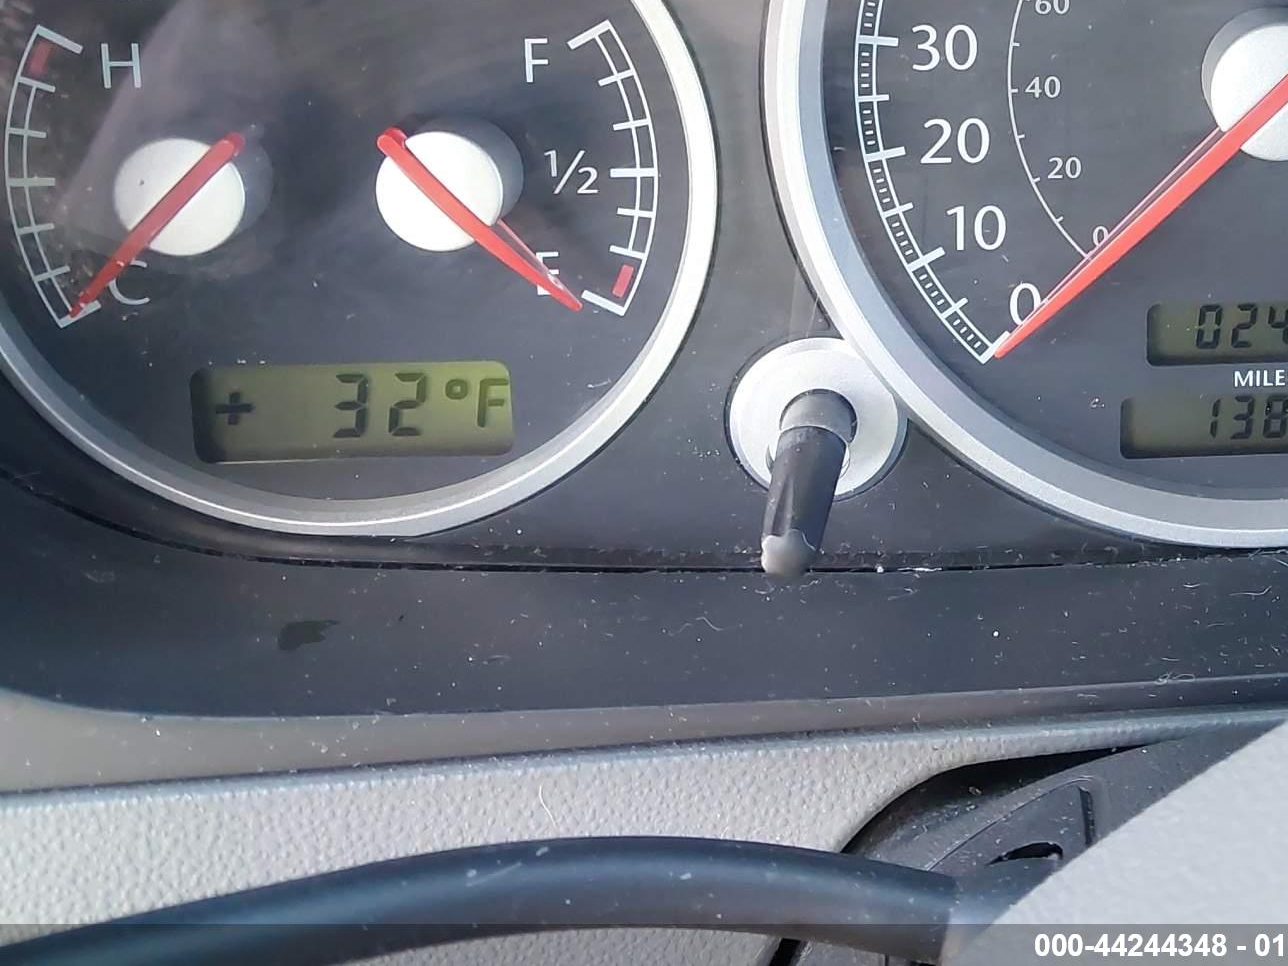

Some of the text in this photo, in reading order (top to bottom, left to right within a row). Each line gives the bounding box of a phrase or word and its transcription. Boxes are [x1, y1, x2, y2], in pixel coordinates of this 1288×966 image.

[100, 42, 141, 89] H
[524, 37, 549, 83] F
[912, 24, 978, 71] 30
[1024, 75, 1061, 99] 40
[920, 117, 990, 164] 20
[1047, 156, 1082, 179] 20
[946, 205, 1007, 251] 10
[109, 258, 150, 305] C
[1009, 282, 1041, 326] 0
